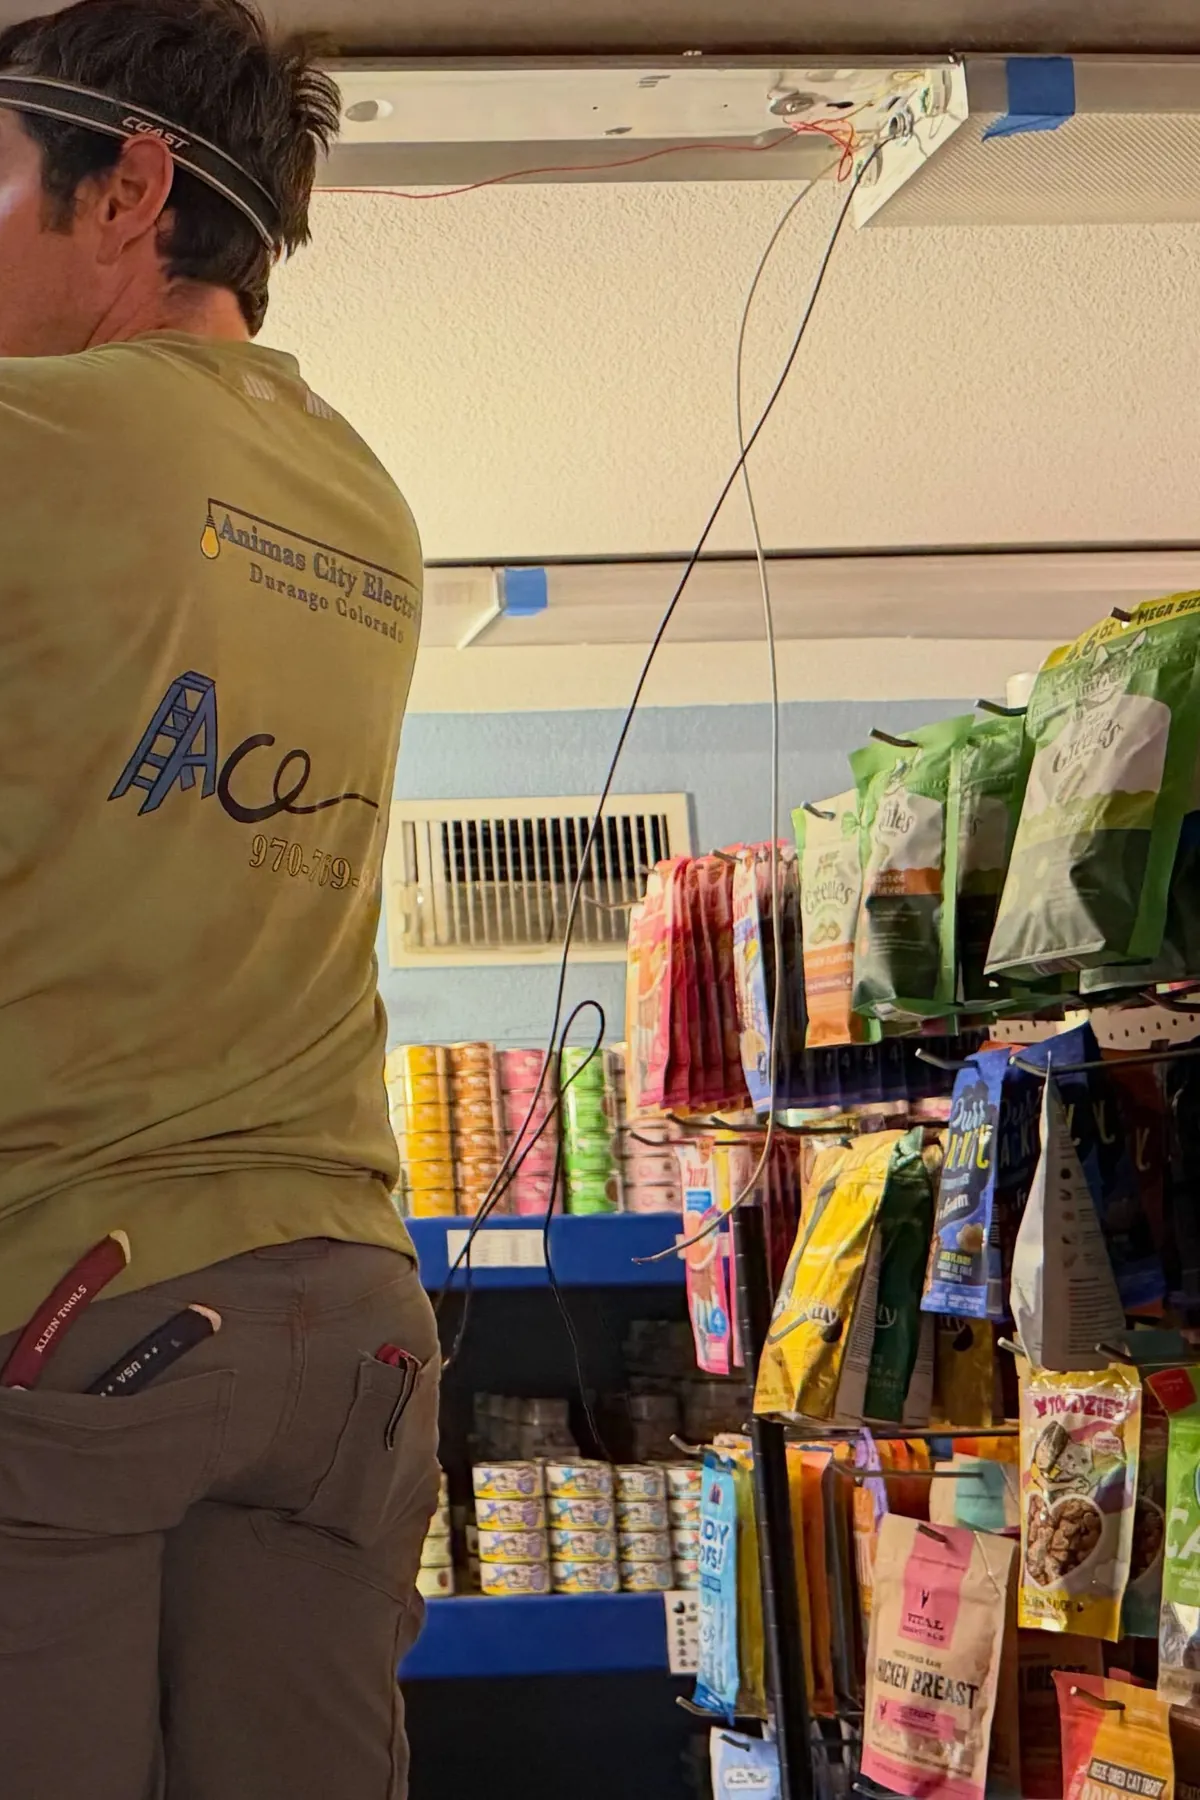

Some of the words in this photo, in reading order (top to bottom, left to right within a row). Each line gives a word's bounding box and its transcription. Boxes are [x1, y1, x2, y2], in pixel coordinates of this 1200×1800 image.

[121, 116, 191, 150] COAST
[219, 514, 306, 571] Animas
[313, 552, 358, 598] City
[249, 562, 329, 612] Durango
[335, 597, 405, 644] Colorado
[1136, 603, 1174, 626] MEGA
[34, 1316, 61, 1355] KLEIN
[57, 1283, 88, 1320] TOOLS
[116, 1359, 142, 1385] USA
[911, 1668, 980, 1710] BREAST
[1126, 1772, 1142, 1791] CAT
